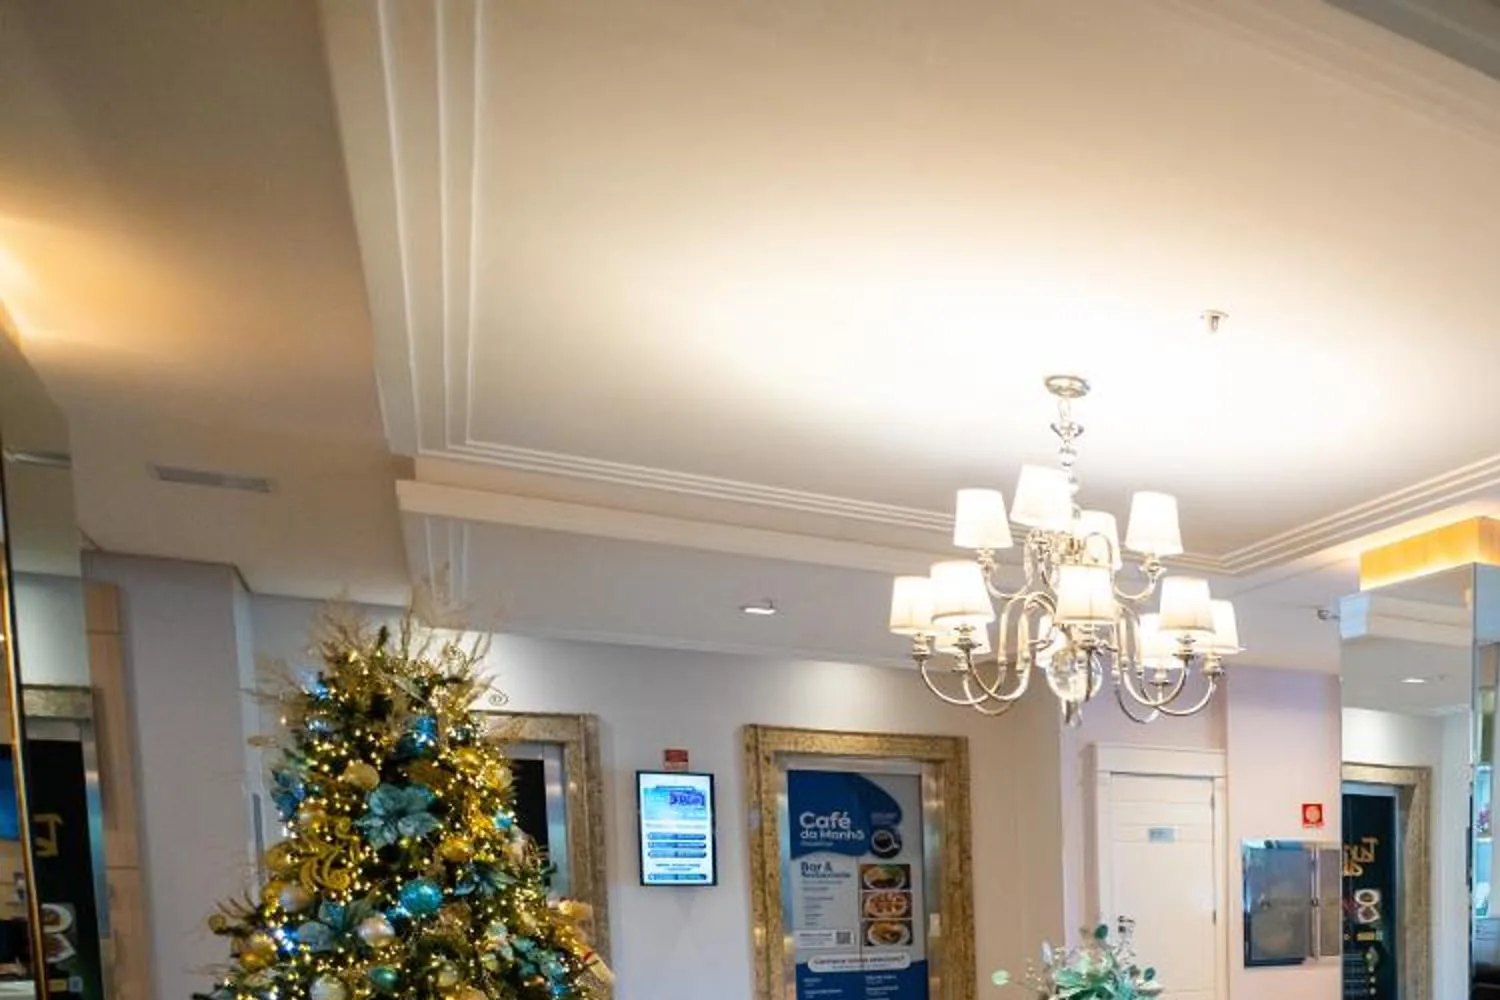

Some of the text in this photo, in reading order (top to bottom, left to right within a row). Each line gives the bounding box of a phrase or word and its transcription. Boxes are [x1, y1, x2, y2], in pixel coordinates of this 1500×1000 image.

[800, 811, 851, 829] Café
[800, 829, 865, 841] da Manhã
[801, 861, 822, 873] Bar
